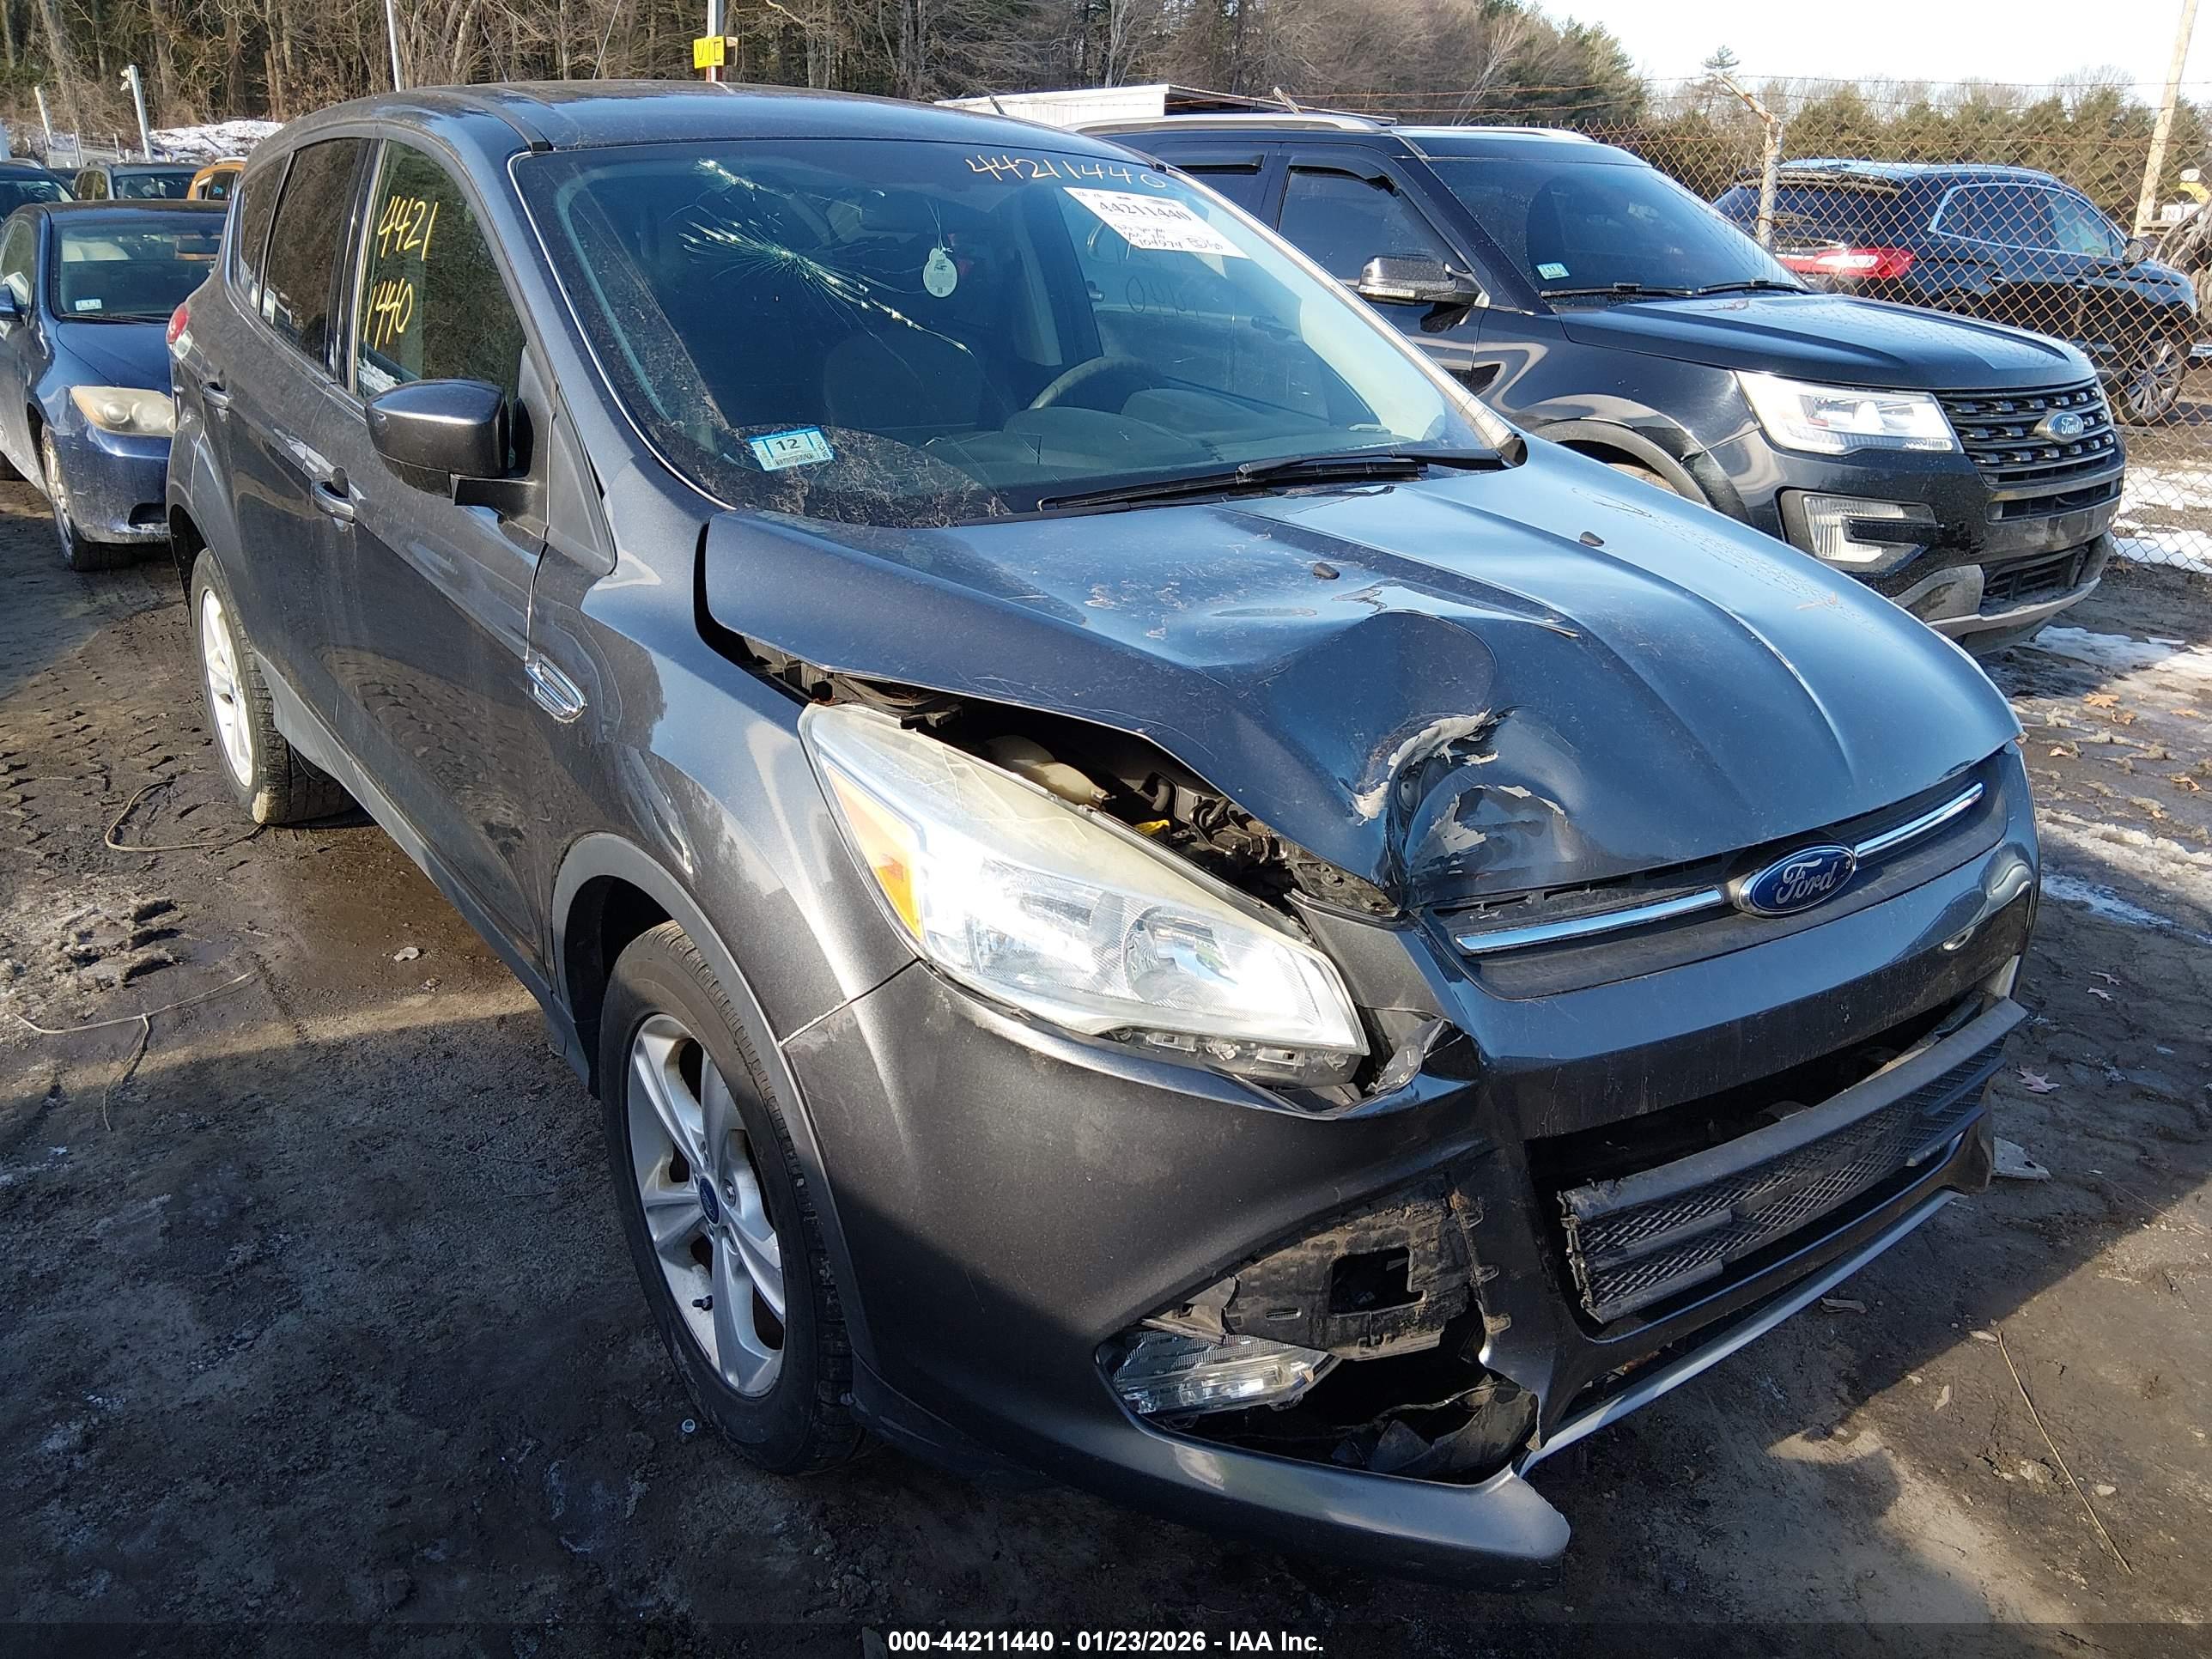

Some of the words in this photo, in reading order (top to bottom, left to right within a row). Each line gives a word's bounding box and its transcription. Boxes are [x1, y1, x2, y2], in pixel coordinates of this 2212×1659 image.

[965, 155, 1167, 188] 44211440
[1099, 201, 1192, 221] 44211440
[378, 195, 439, 261] 4421
[364, 277, 412, 350] 1440
[2061, 416, 2079, 434] Ford
[775, 438, 801, 452] 12
[1775, 857, 1838, 904] Ford
